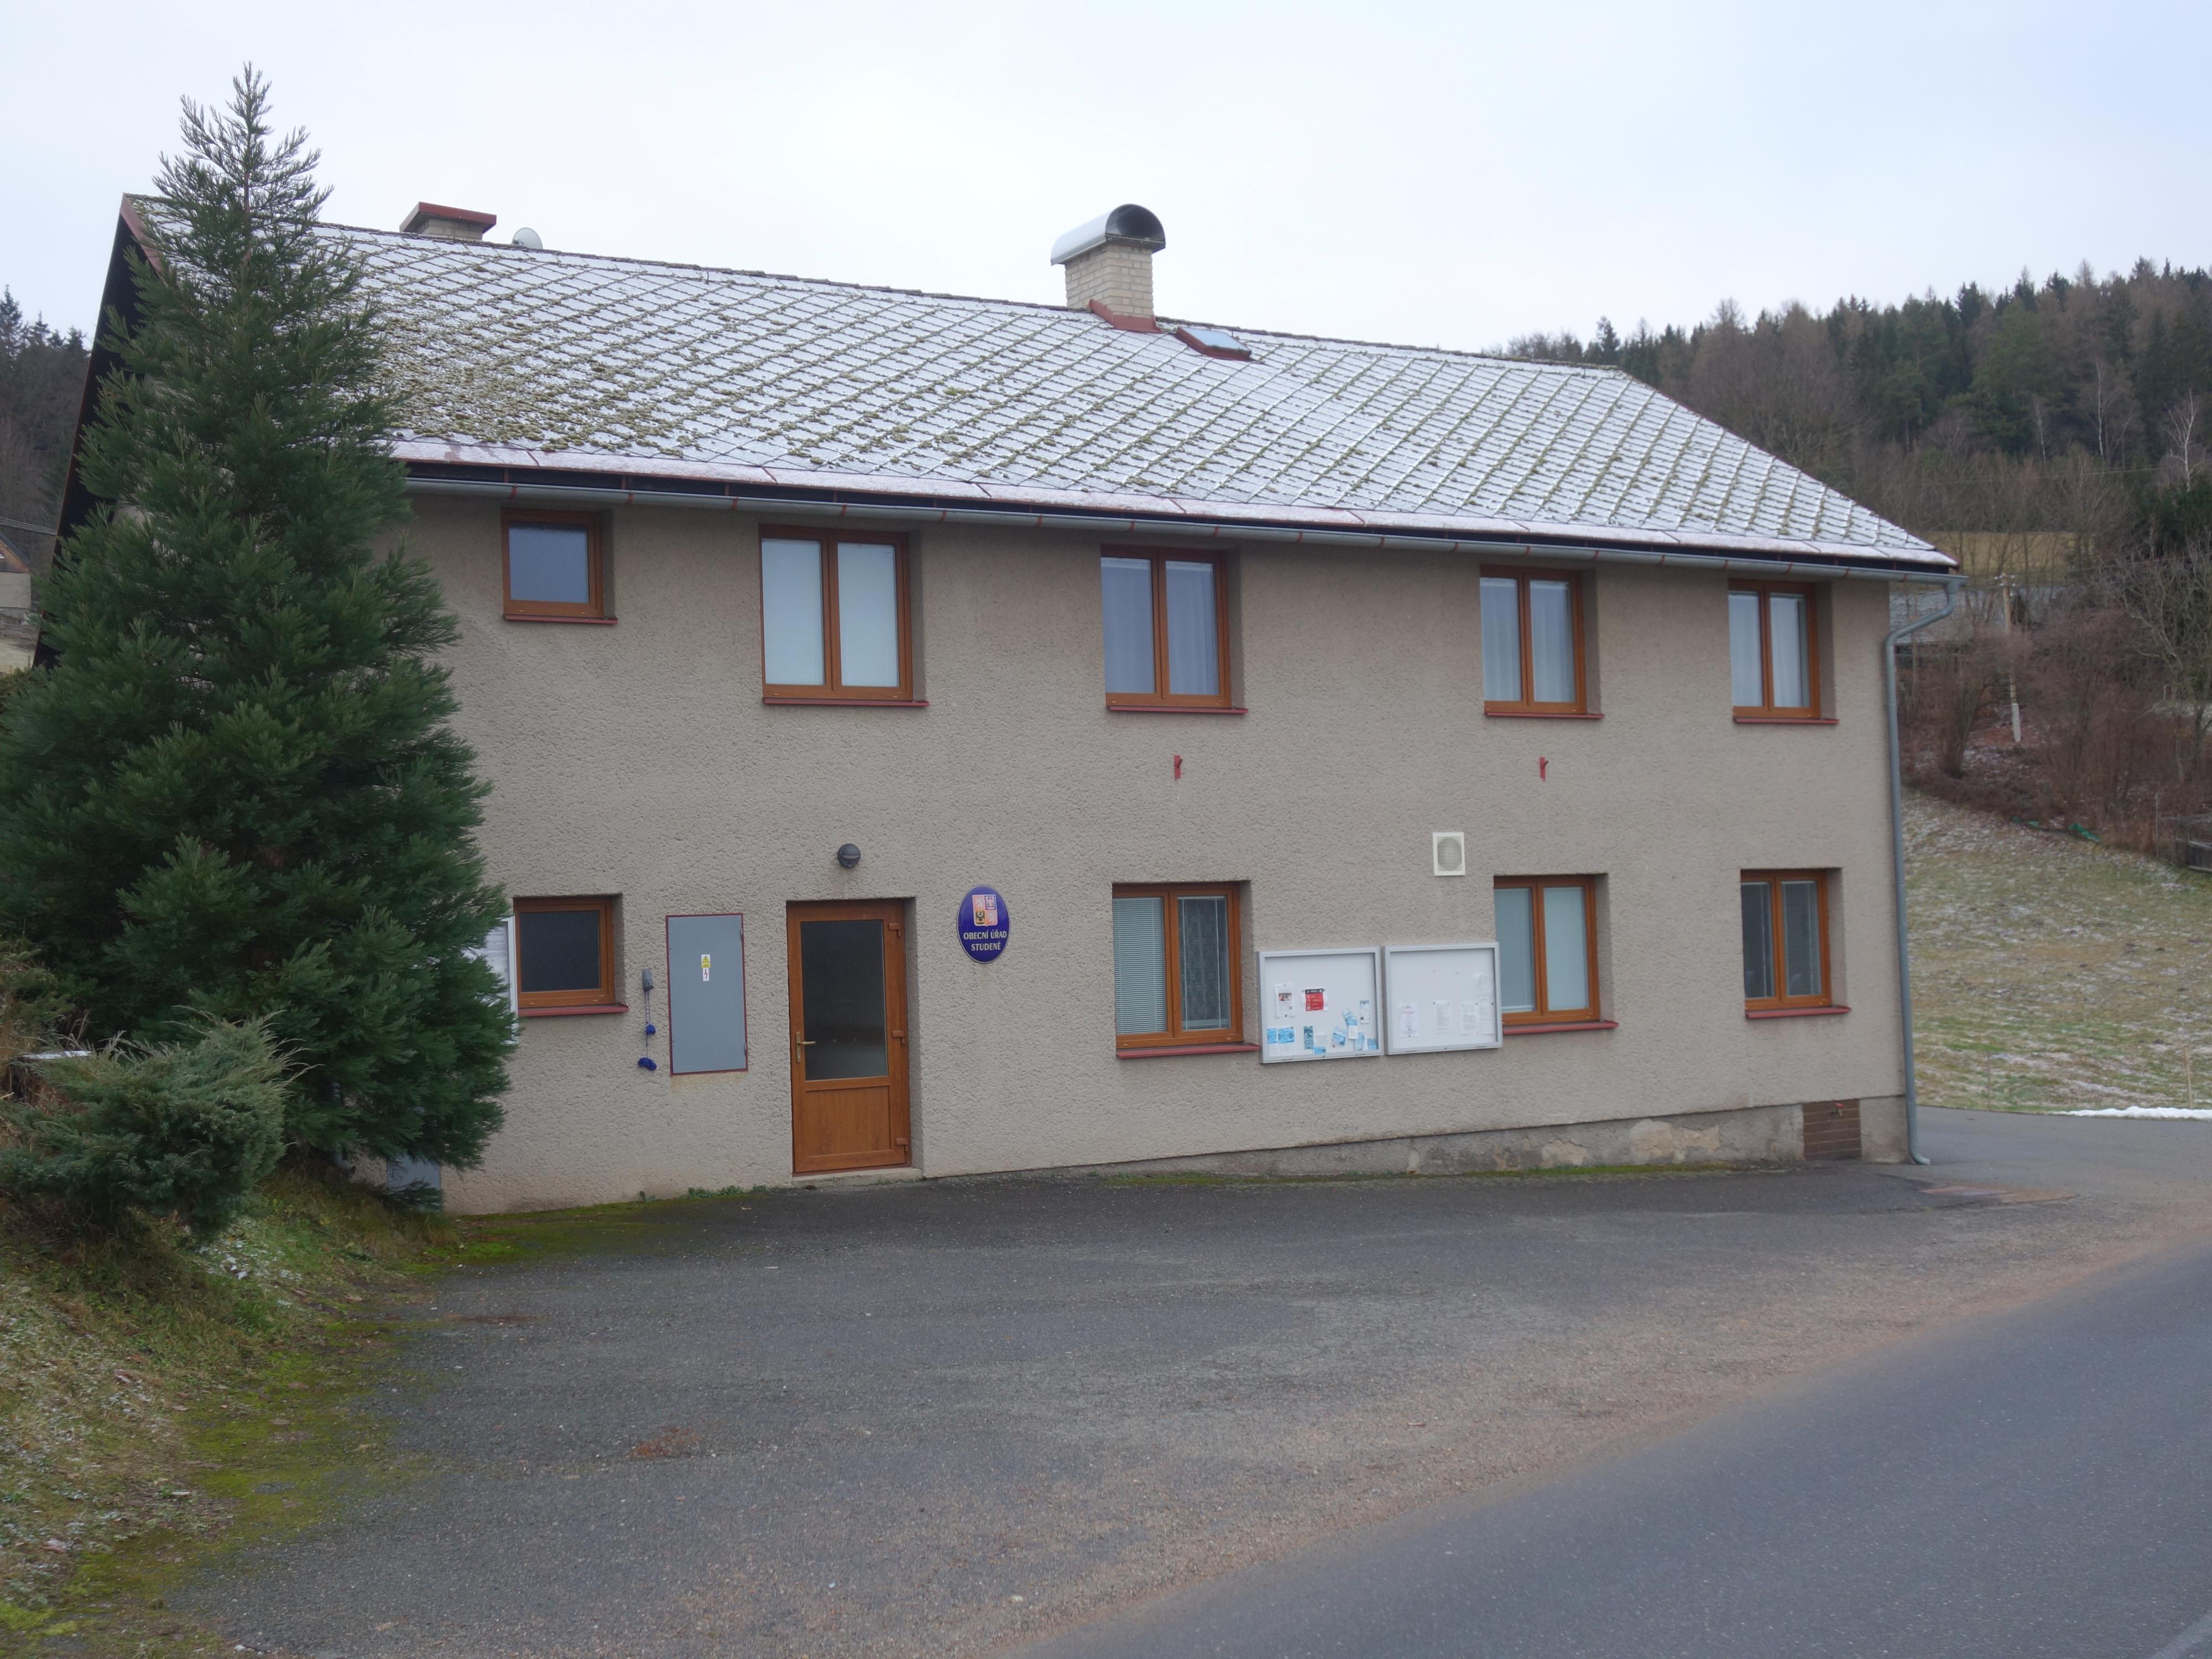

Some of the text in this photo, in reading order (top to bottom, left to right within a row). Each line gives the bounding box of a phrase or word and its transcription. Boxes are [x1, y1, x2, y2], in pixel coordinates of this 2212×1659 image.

[963, 929, 1007, 940] OBECNÍ ÚŘAD
[971, 941, 1001, 951] STUDENÉ
